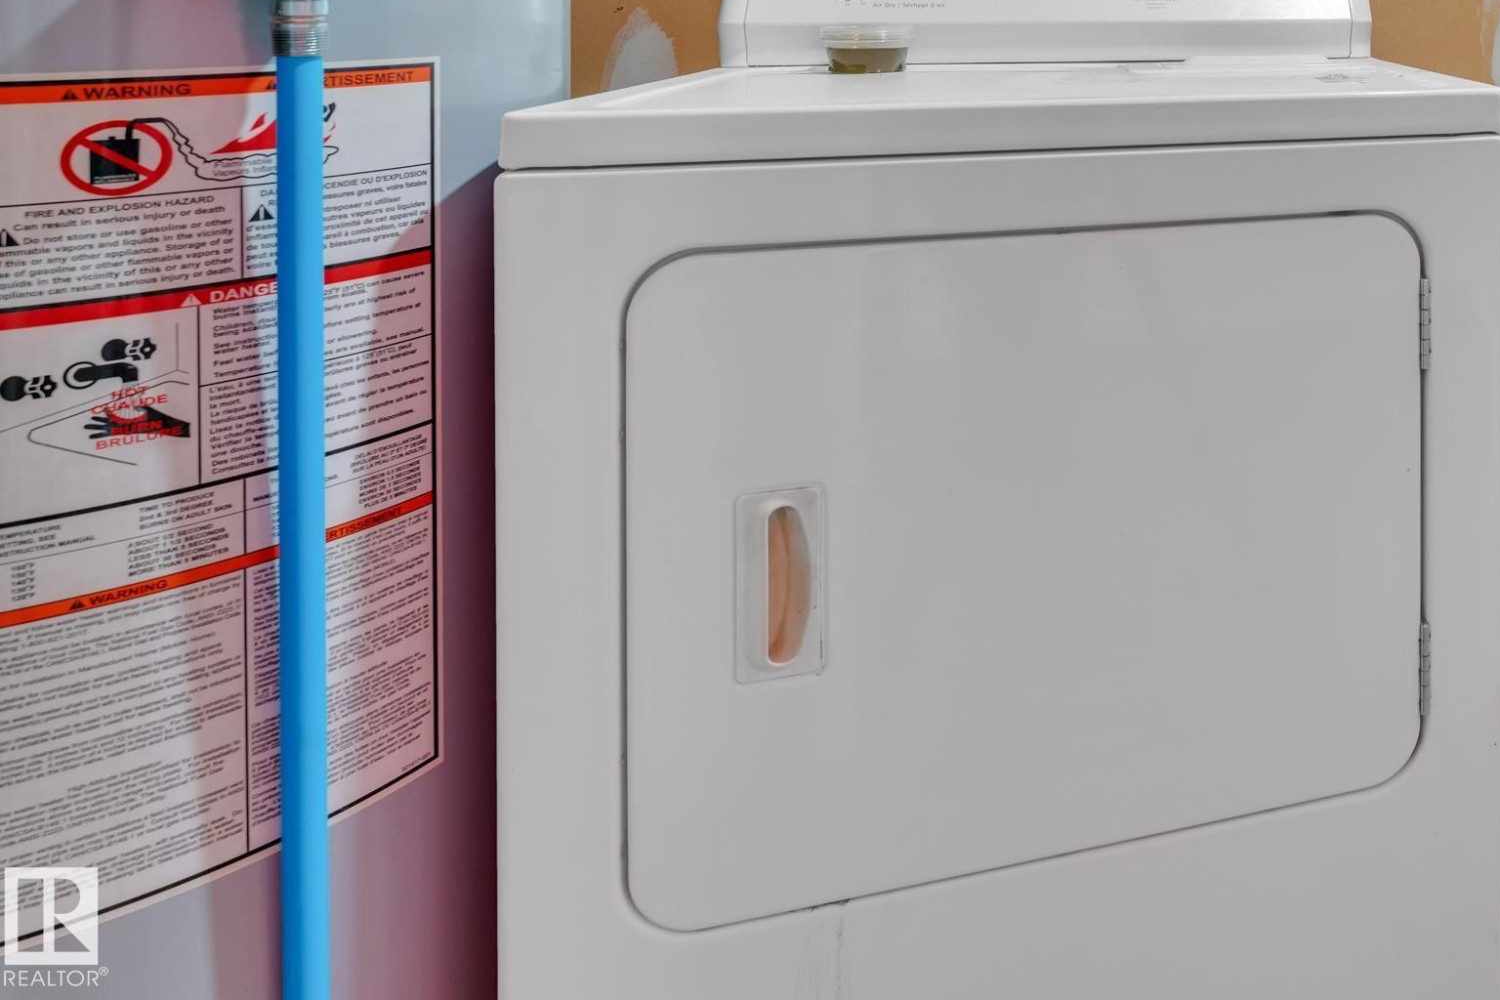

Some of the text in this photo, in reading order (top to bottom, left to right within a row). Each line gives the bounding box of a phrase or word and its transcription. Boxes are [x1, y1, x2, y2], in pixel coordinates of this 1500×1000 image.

[84, 84, 191, 99] WARNING
[325, 169, 427, 188] CENDIE OU D'EXPLOSION
[325, 190, 354, 198] essures
[24, 195, 214, 218] FIRE AND EXPLOSION HAZARD
[41, 218, 76, 228] result
[95, 214, 139, 223] serious
[143, 211, 176, 219] injury
[194, 205, 225, 213] death
[43, 234, 62, 242] not
[66, 232, 96, 240] store
[140, 224, 187, 235] gasoline
[55, 243, 93, 252] vapors
[98, 239, 118, 247] and
[122, 235, 159, 246] liquids
[197, 228, 232, 237] vicinity
[5, 259, 25, 267] this
[47, 255, 67, 263] any
[71, 252, 99, 260] other
[165, 241, 206, 250] Storage
[30, 265, 76, 277] gasoline
[95, 259, 123, 267] other
[128, 253, 182, 264] flammable
[185, 249, 219, 258] vapors
[52, 275, 71, 283] the
[77, 270, 118, 280] vicinity
[124, 267, 135, 275] of
[70, 281, 102, 291] result
[118, 276, 157, 285] serious
[160, 273, 189, 281] injury
[209, 281, 278, 303] DANGE
[111, 385, 148, 400] HOT
[91, 394, 168, 415] CHAUDE
[326, 508, 402, 539] RTISSEMENT
[89, 579, 169, 605] WARNING
